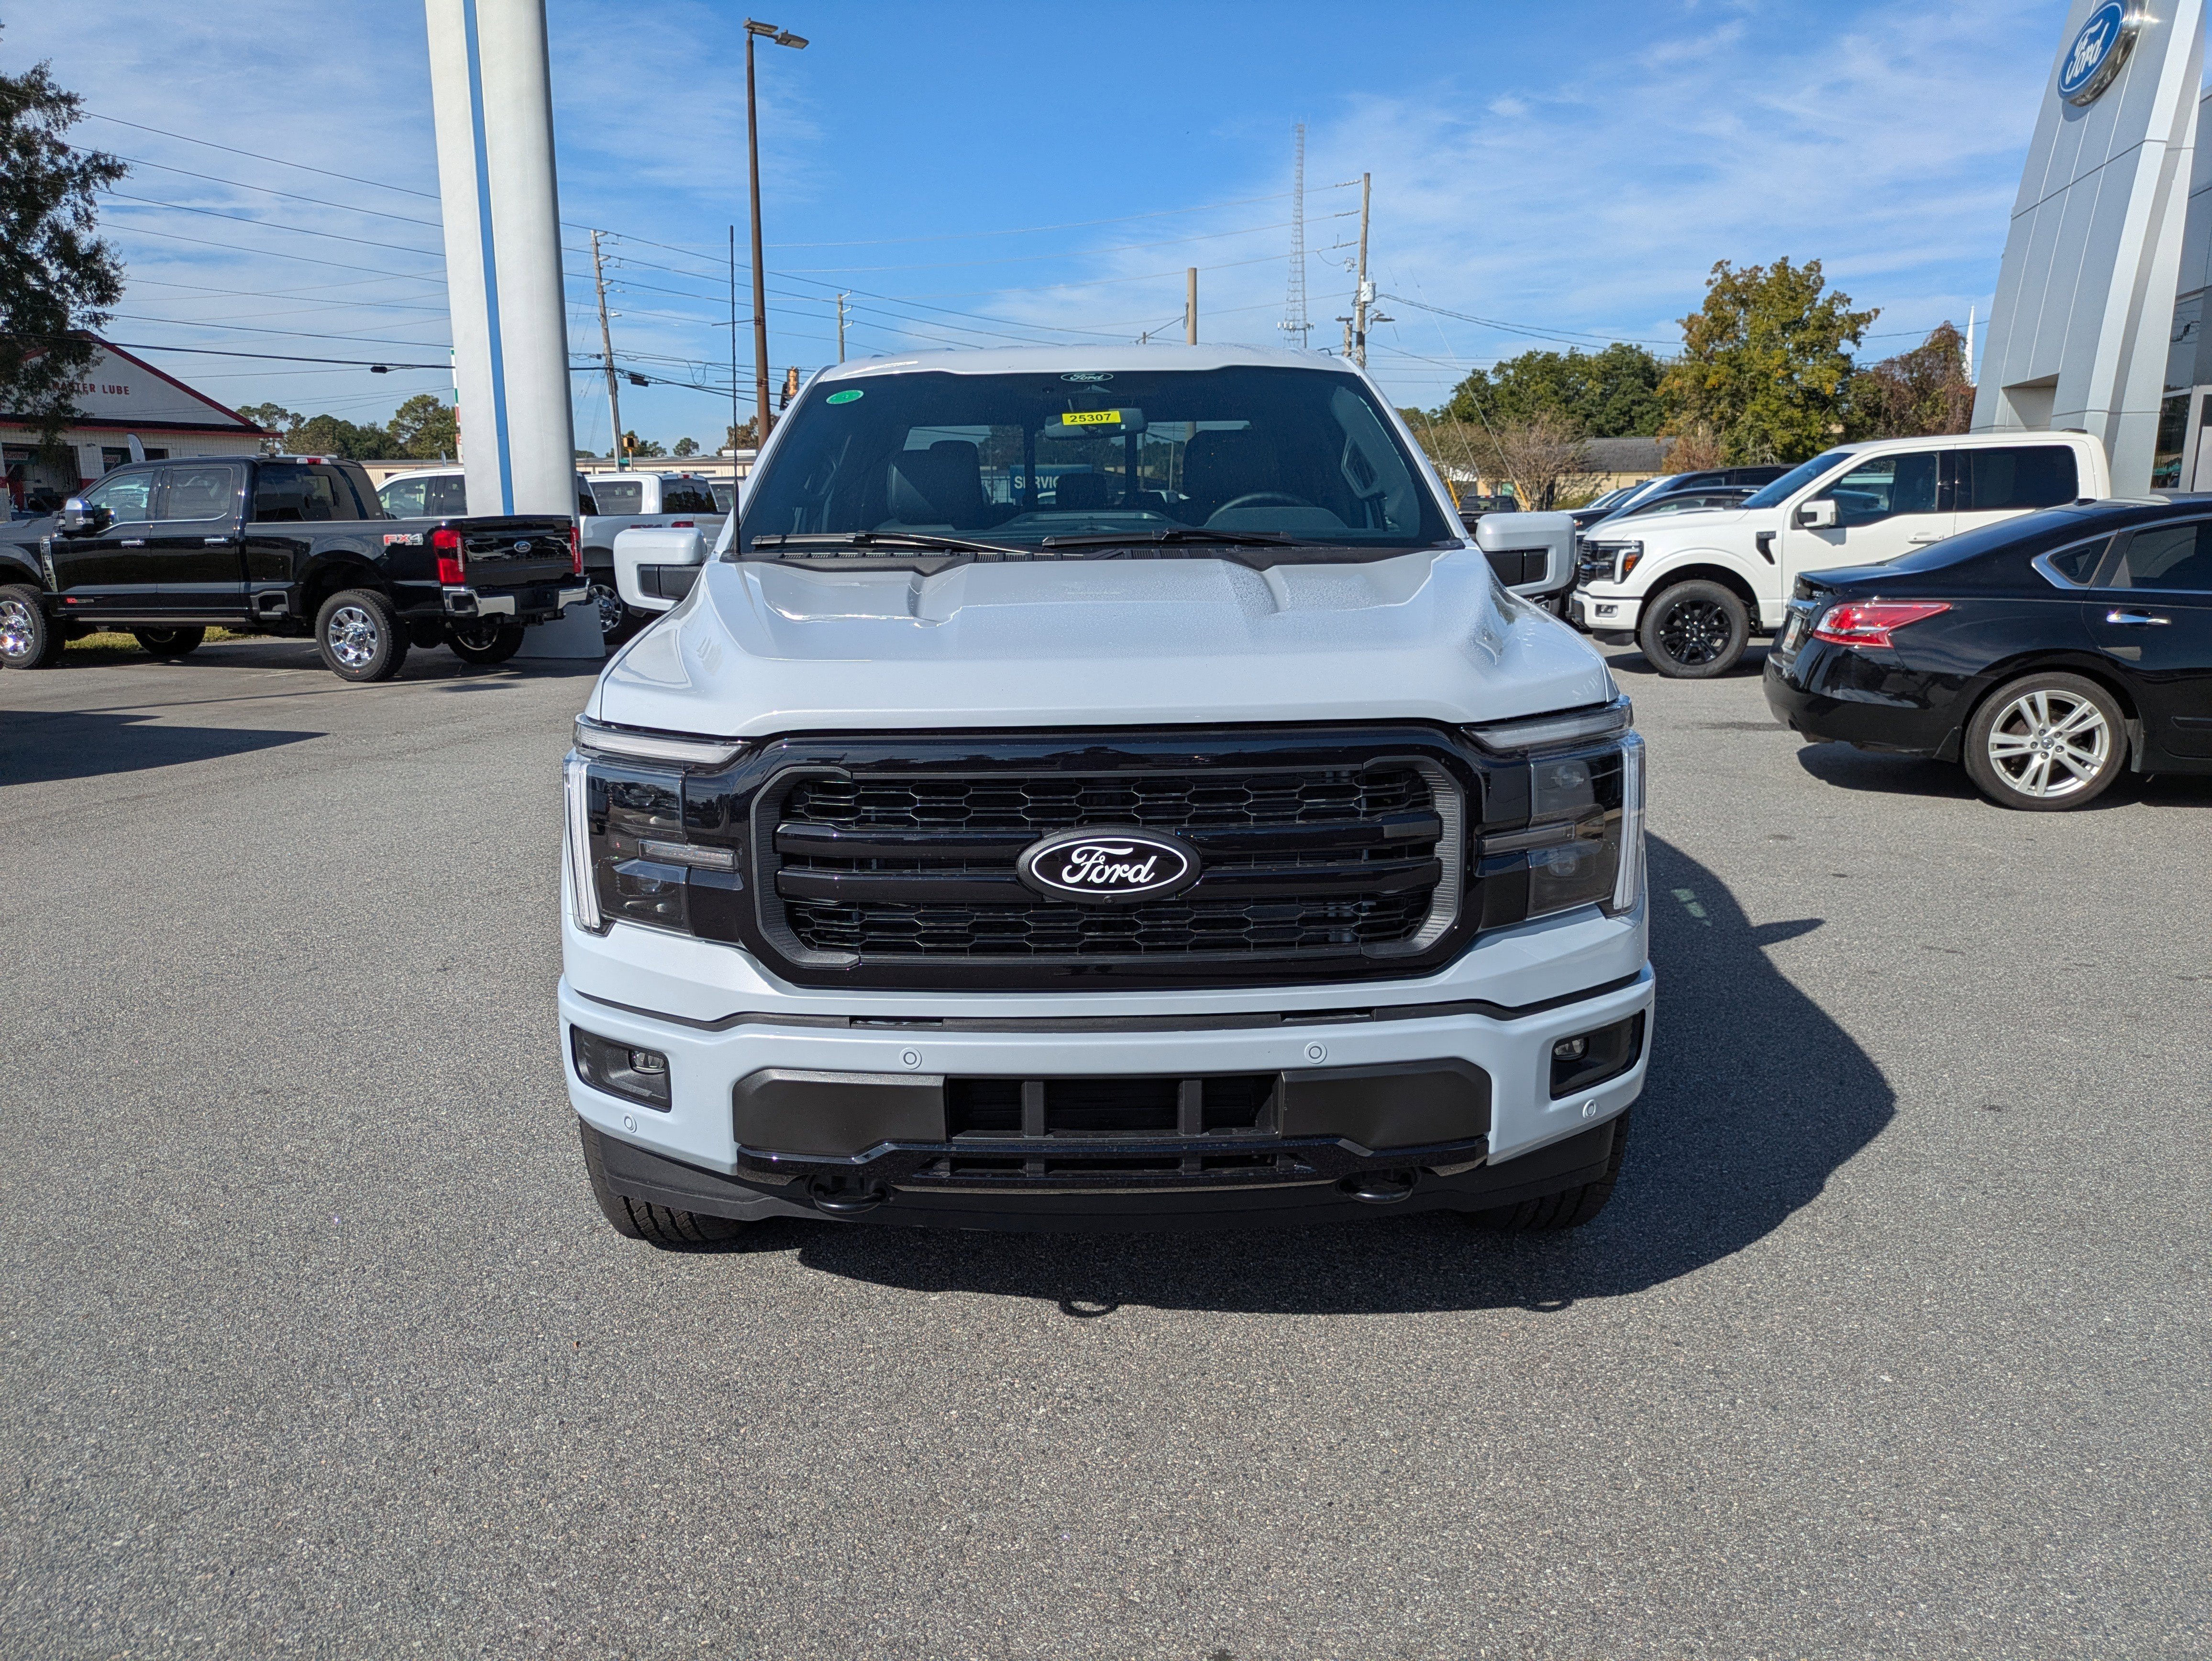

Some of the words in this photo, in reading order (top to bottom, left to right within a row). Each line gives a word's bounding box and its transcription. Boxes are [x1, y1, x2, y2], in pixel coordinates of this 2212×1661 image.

[2066, 19, 2110, 85] Ford
[102, 385, 130, 395] LUBE
[1069, 413, 1111, 422] 25307
[1014, 476, 1059, 489] SRVIC
[384, 533, 423, 546] FX4
[1062, 846, 1158, 884] Ford
